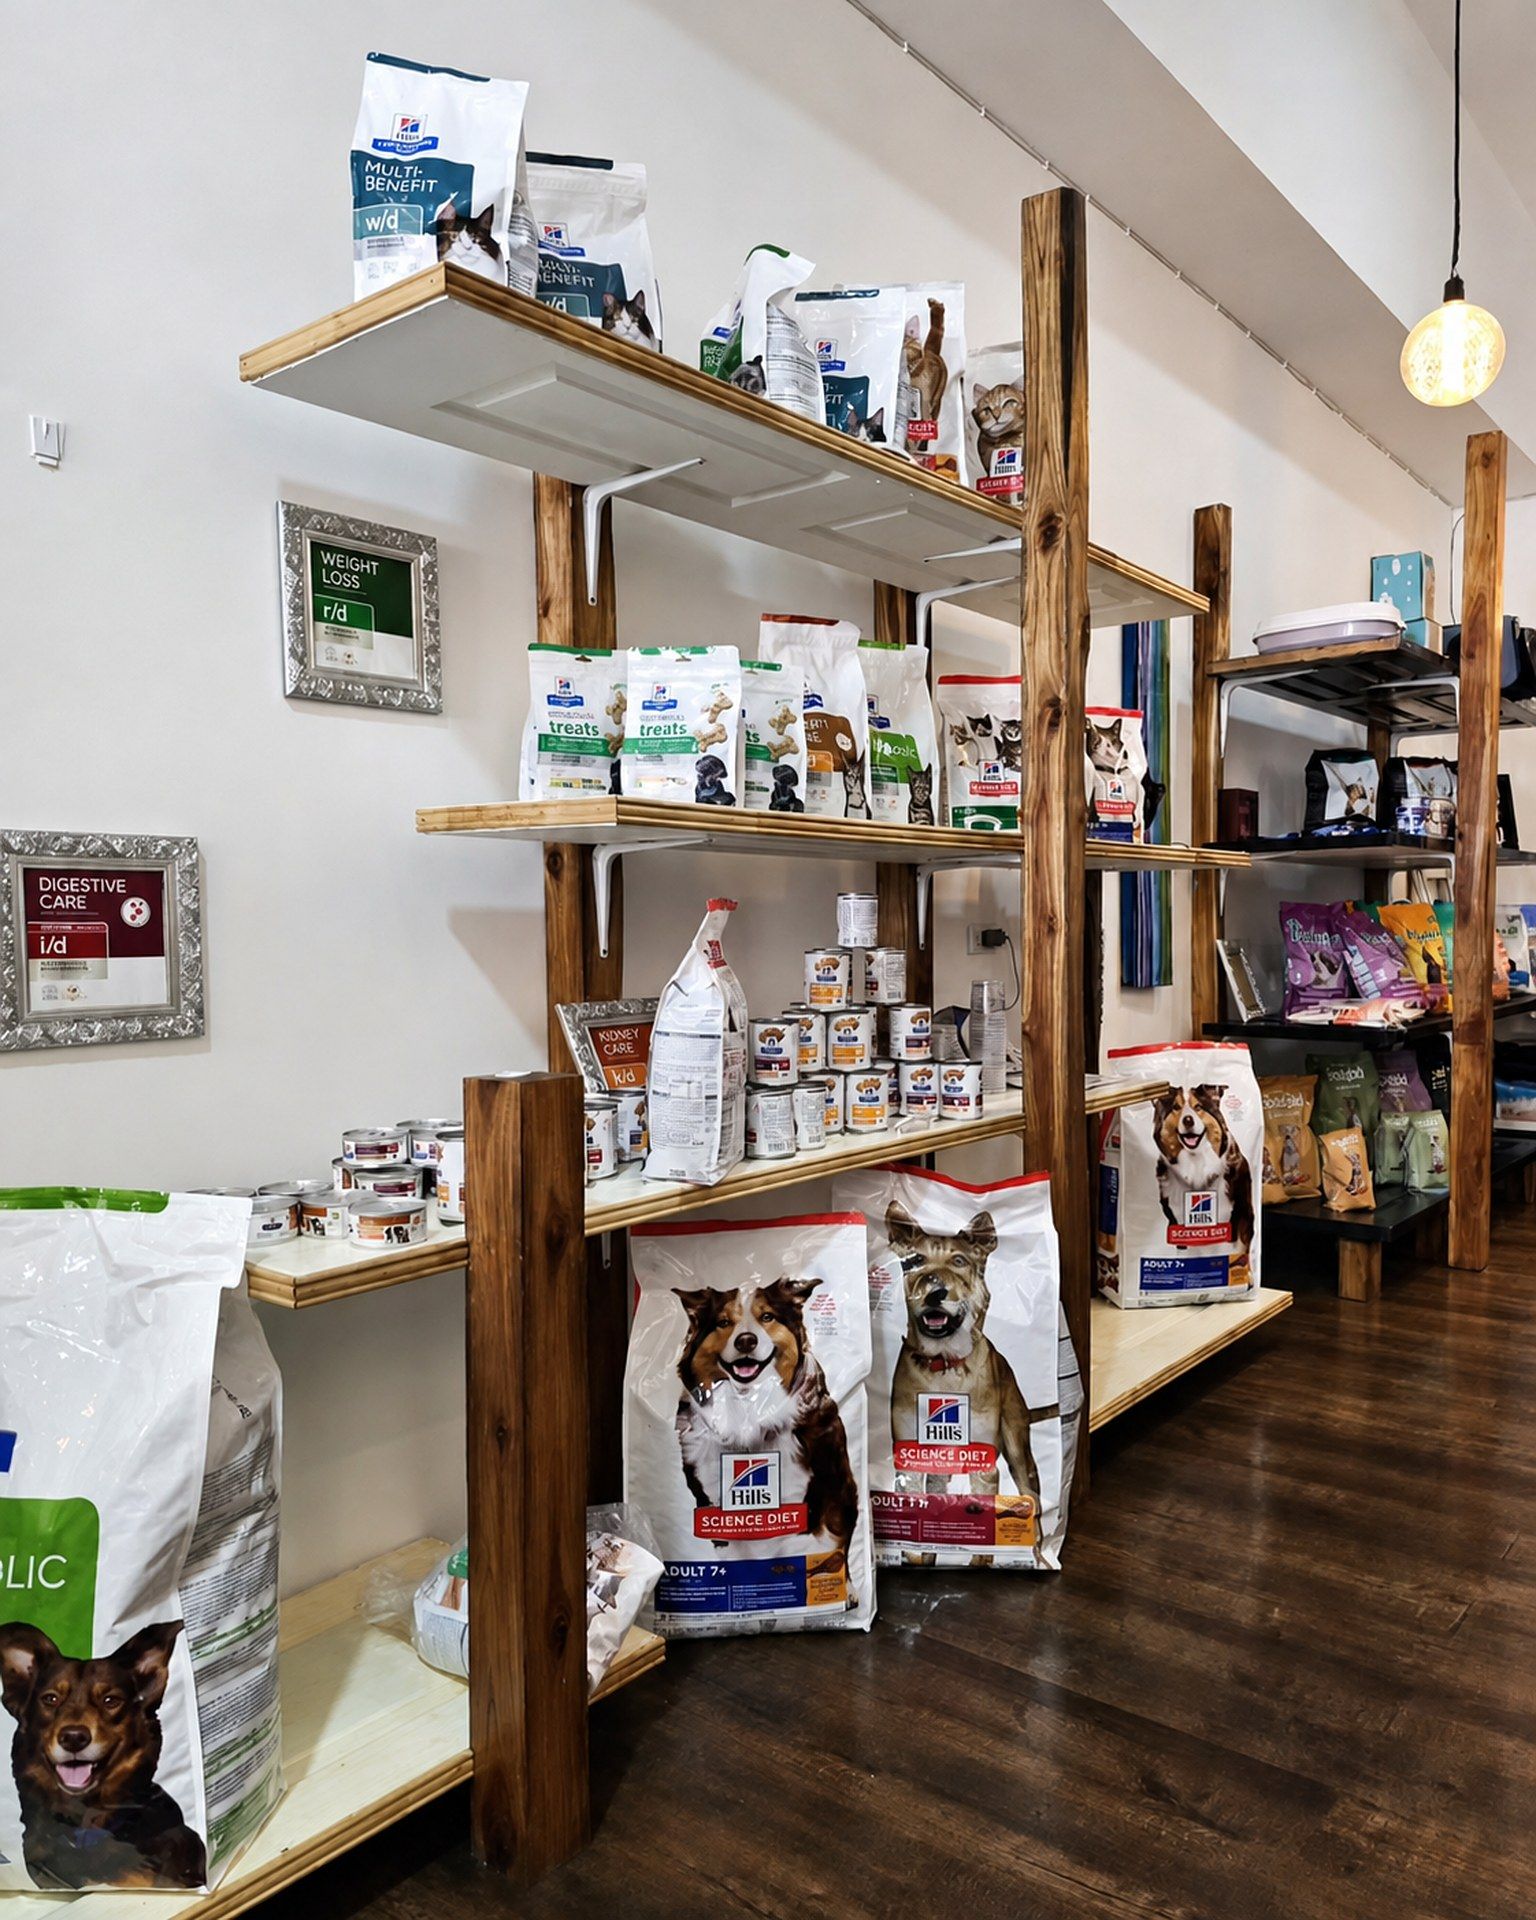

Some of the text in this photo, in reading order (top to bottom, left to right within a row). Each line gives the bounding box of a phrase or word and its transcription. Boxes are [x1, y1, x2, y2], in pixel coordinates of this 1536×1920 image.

[365, 160, 423, 178] MULTI-
[365, 175, 438, 193] BENEFIT
[365, 208, 399, 232] w/d
[539, 271, 595, 288] ENEFIT
[320, 550, 379, 576] WEIGHT
[322, 568, 360, 589] LOSS
[323, 602, 348, 622] r/d
[549, 720, 599, 736] treats
[640, 722, 687, 736] treats
[39, 877, 126, 893] DIGESTIVE
[39, 894, 87, 910] CARE
[40, 936, 67, 954] i/d
[599, 1027, 639, 1042] KIDNEY
[611, 1068, 635, 1087] k/d
[926, 1425, 962, 1441] Hill's
[899, 1447, 987, 1462] SCIENCE DIET
[731, 1488, 772, 1506] Hill's
[702, 1511, 799, 1527] SCIENCE DIET
[711, 1565, 727, 1577] 7+
